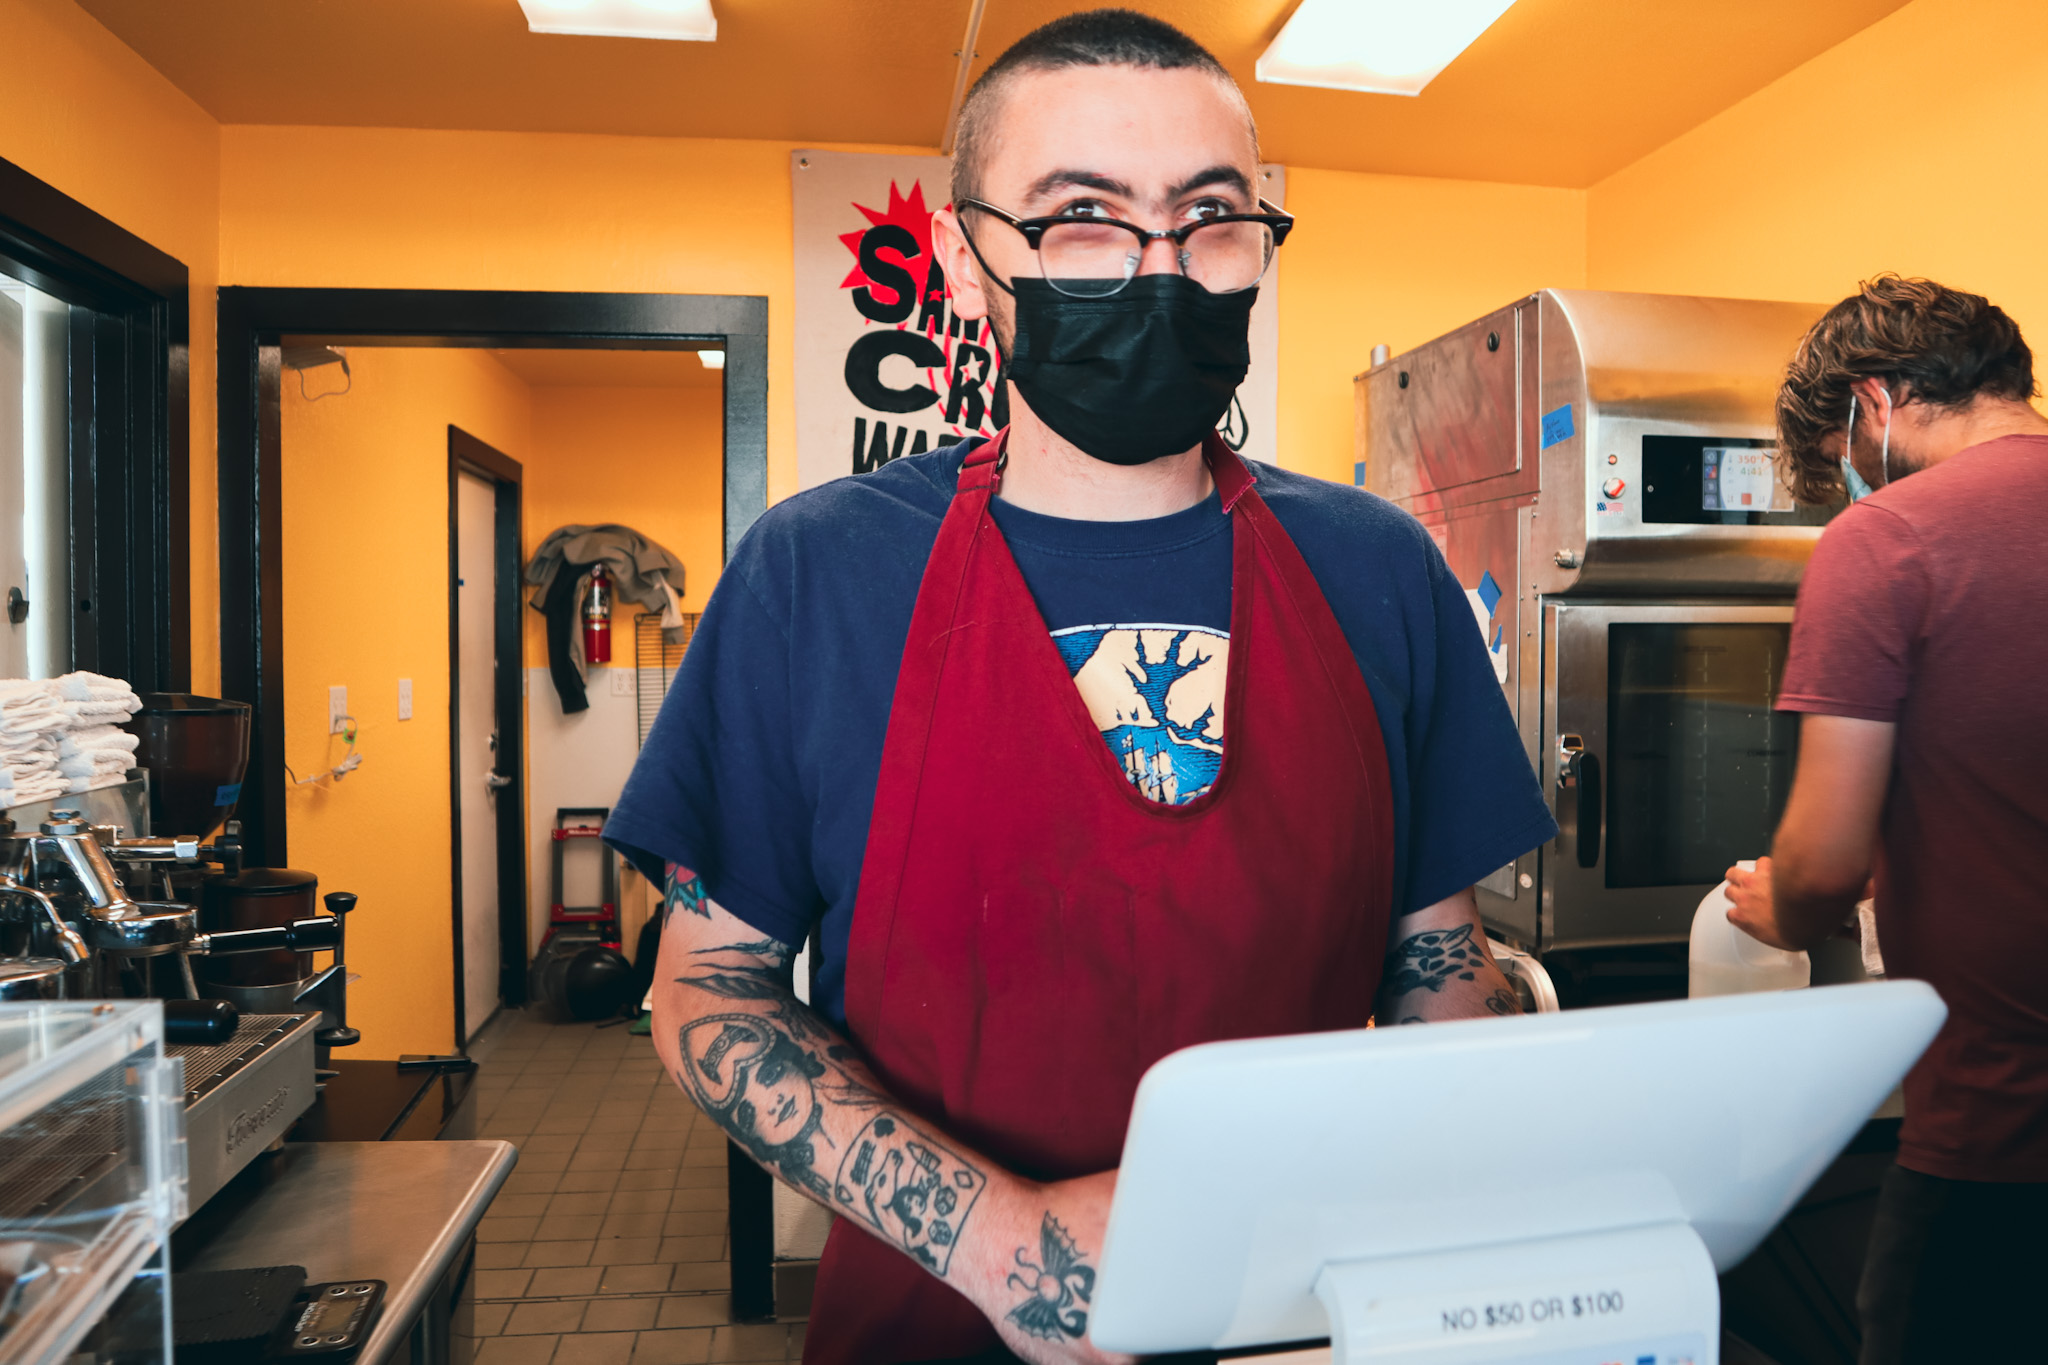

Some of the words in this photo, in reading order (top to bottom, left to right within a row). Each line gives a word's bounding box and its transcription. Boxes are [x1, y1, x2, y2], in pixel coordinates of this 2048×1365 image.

[1442, 1308, 1477, 1331] NO
[1486, 1303, 1524, 1327] $50
[1531, 1298, 1565, 1321] OR
[1572, 1290, 1624, 1317] $100
